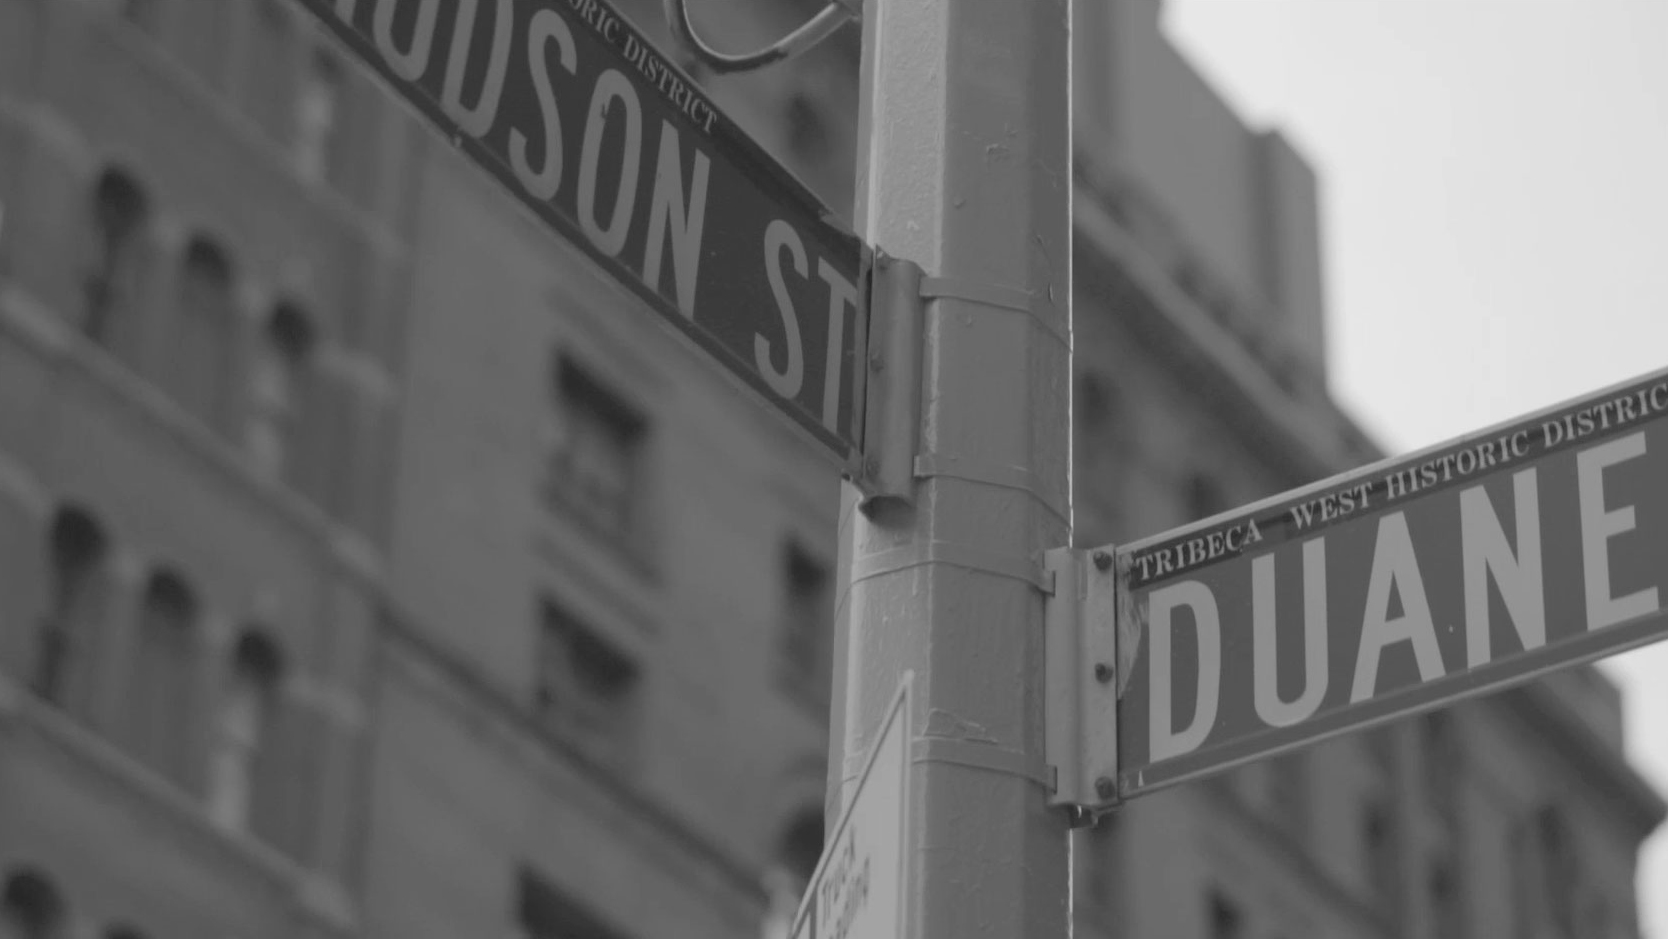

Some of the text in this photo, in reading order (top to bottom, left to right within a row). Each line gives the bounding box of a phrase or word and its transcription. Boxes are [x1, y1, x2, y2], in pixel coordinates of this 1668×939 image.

[623, 34, 717, 133] DISTRICT
[335, 0, 857, 435] DSON ST
[1135, 518, 1263, 581] TRIBECA
[1289, 481, 1374, 530] WEST
[1385, 430, 1530, 500] HISTORIC
[1149, 431, 1660, 764] DUANE
